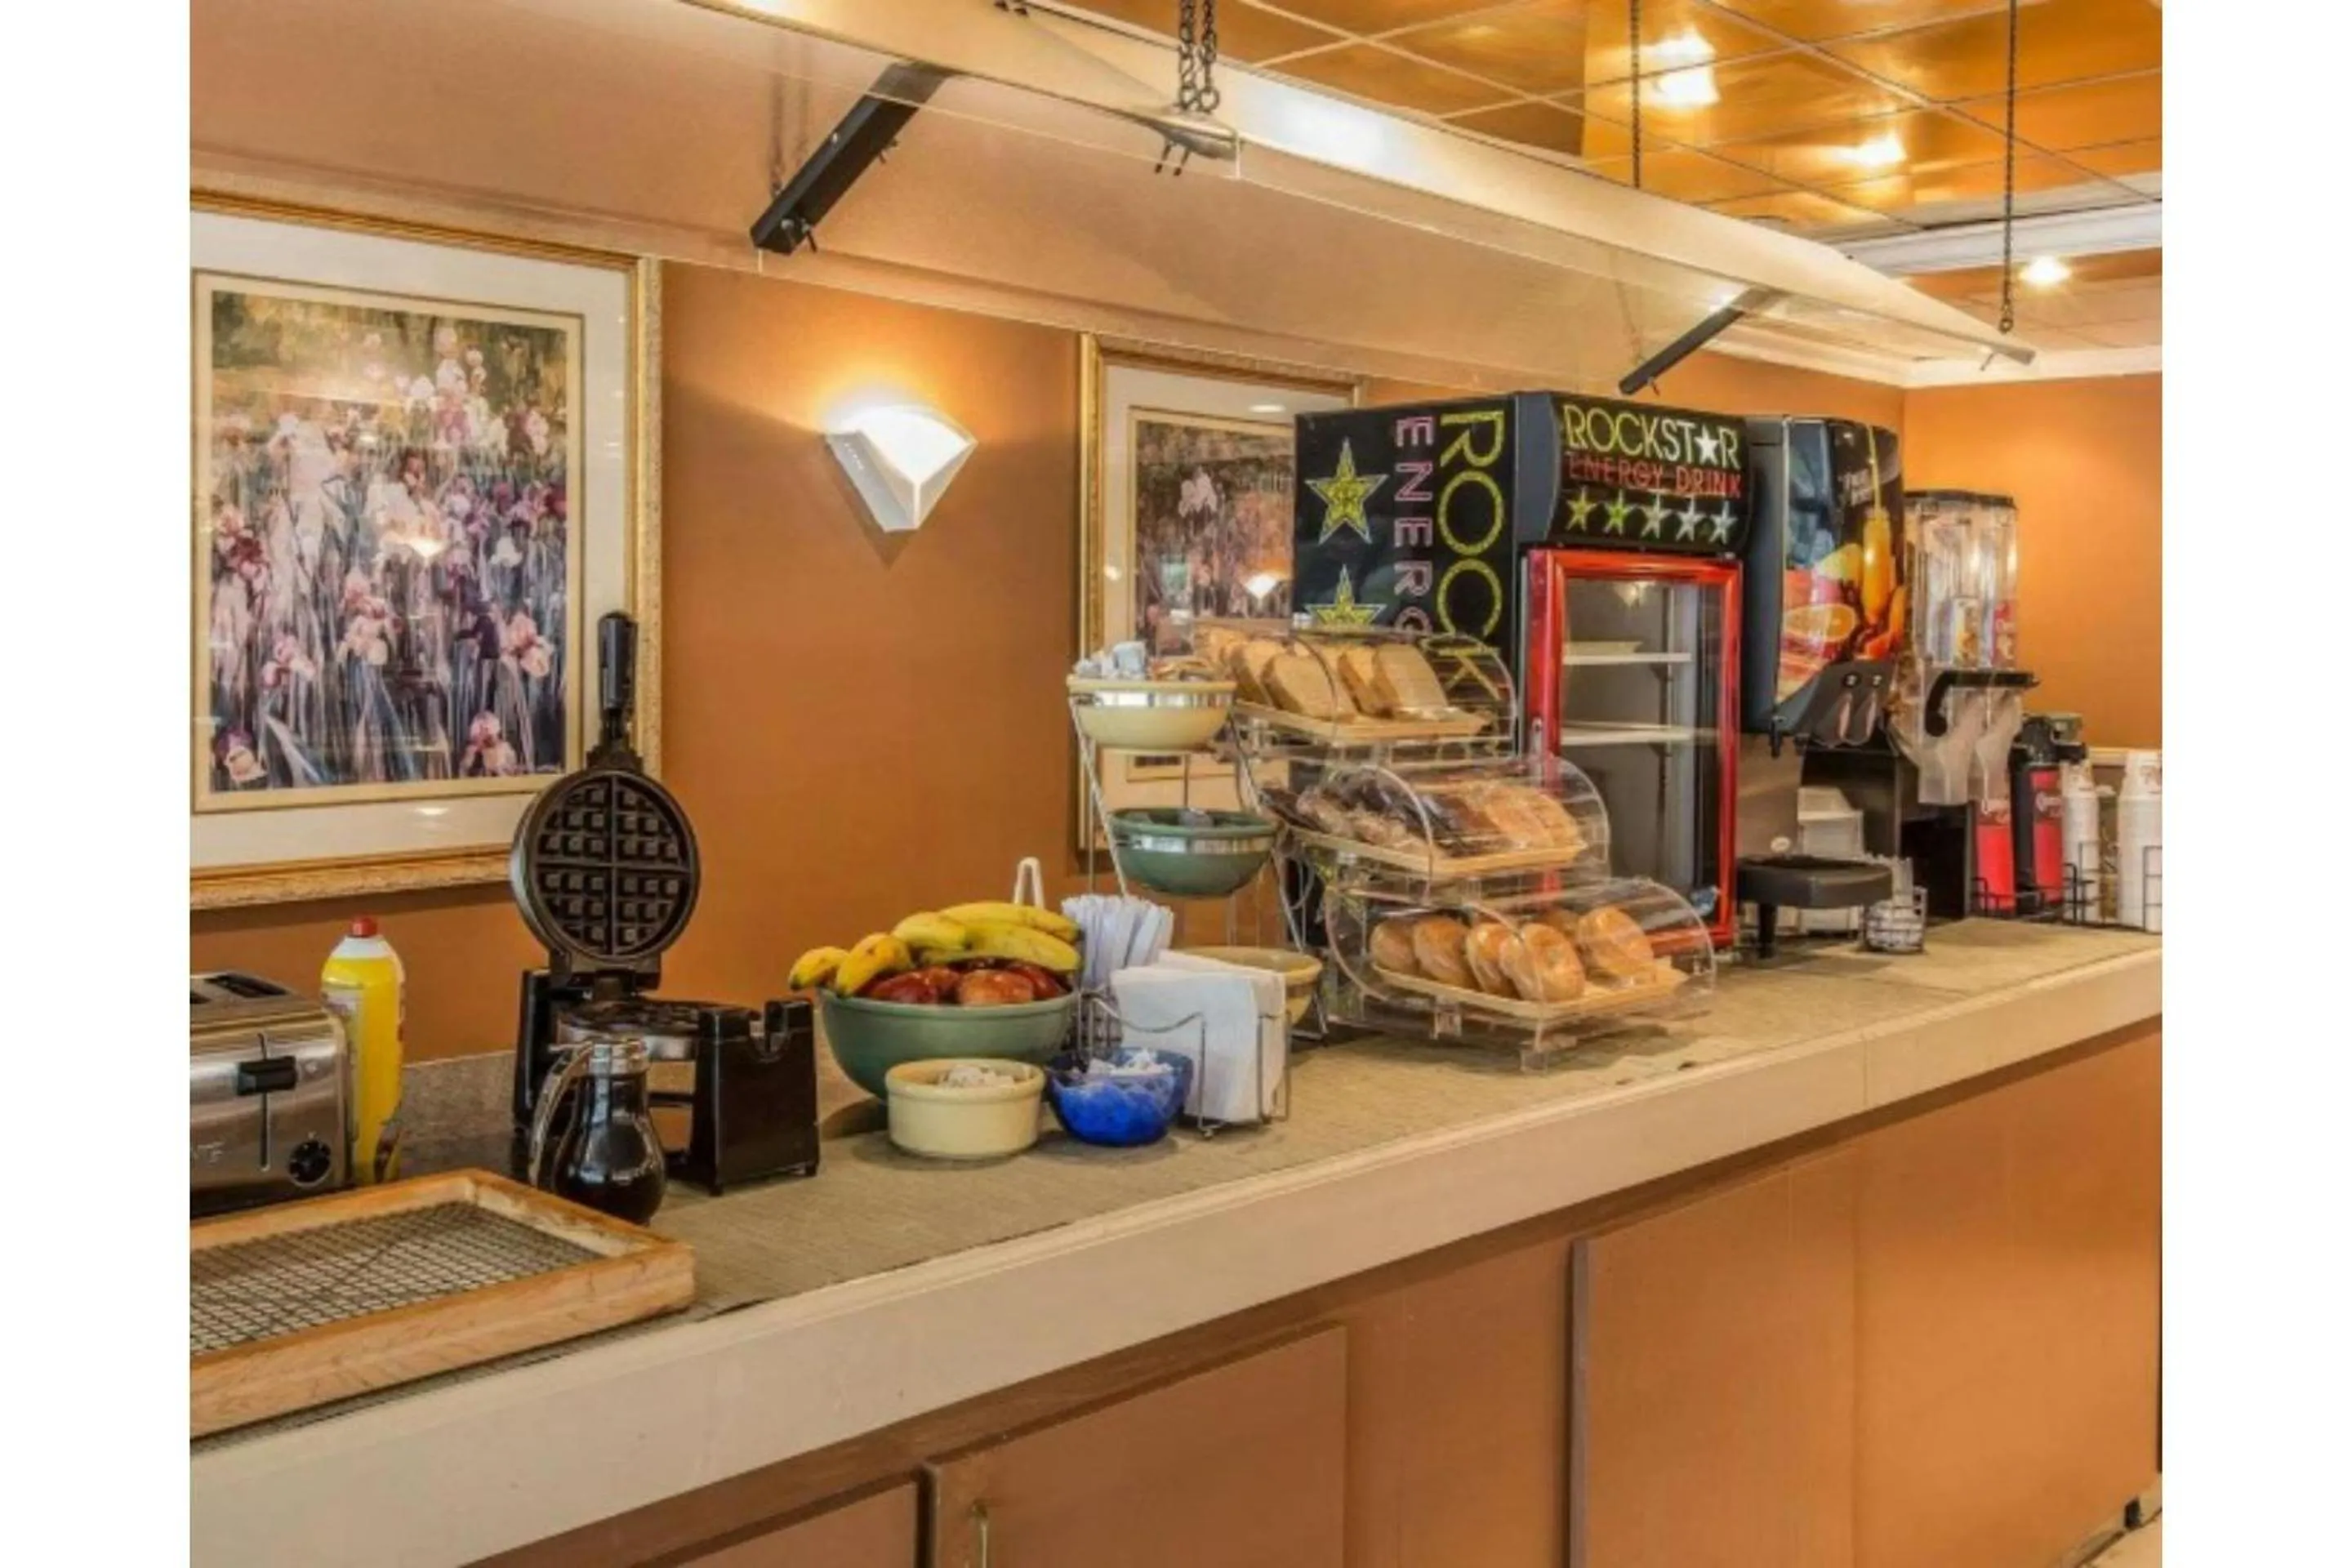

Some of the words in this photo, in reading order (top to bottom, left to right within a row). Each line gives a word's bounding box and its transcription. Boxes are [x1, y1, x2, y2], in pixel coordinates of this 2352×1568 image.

[1393, 415, 1435, 639] ENERG
[1564, 450, 1664, 491] ENERGY
[1675, 464, 1741, 500] DRINK
